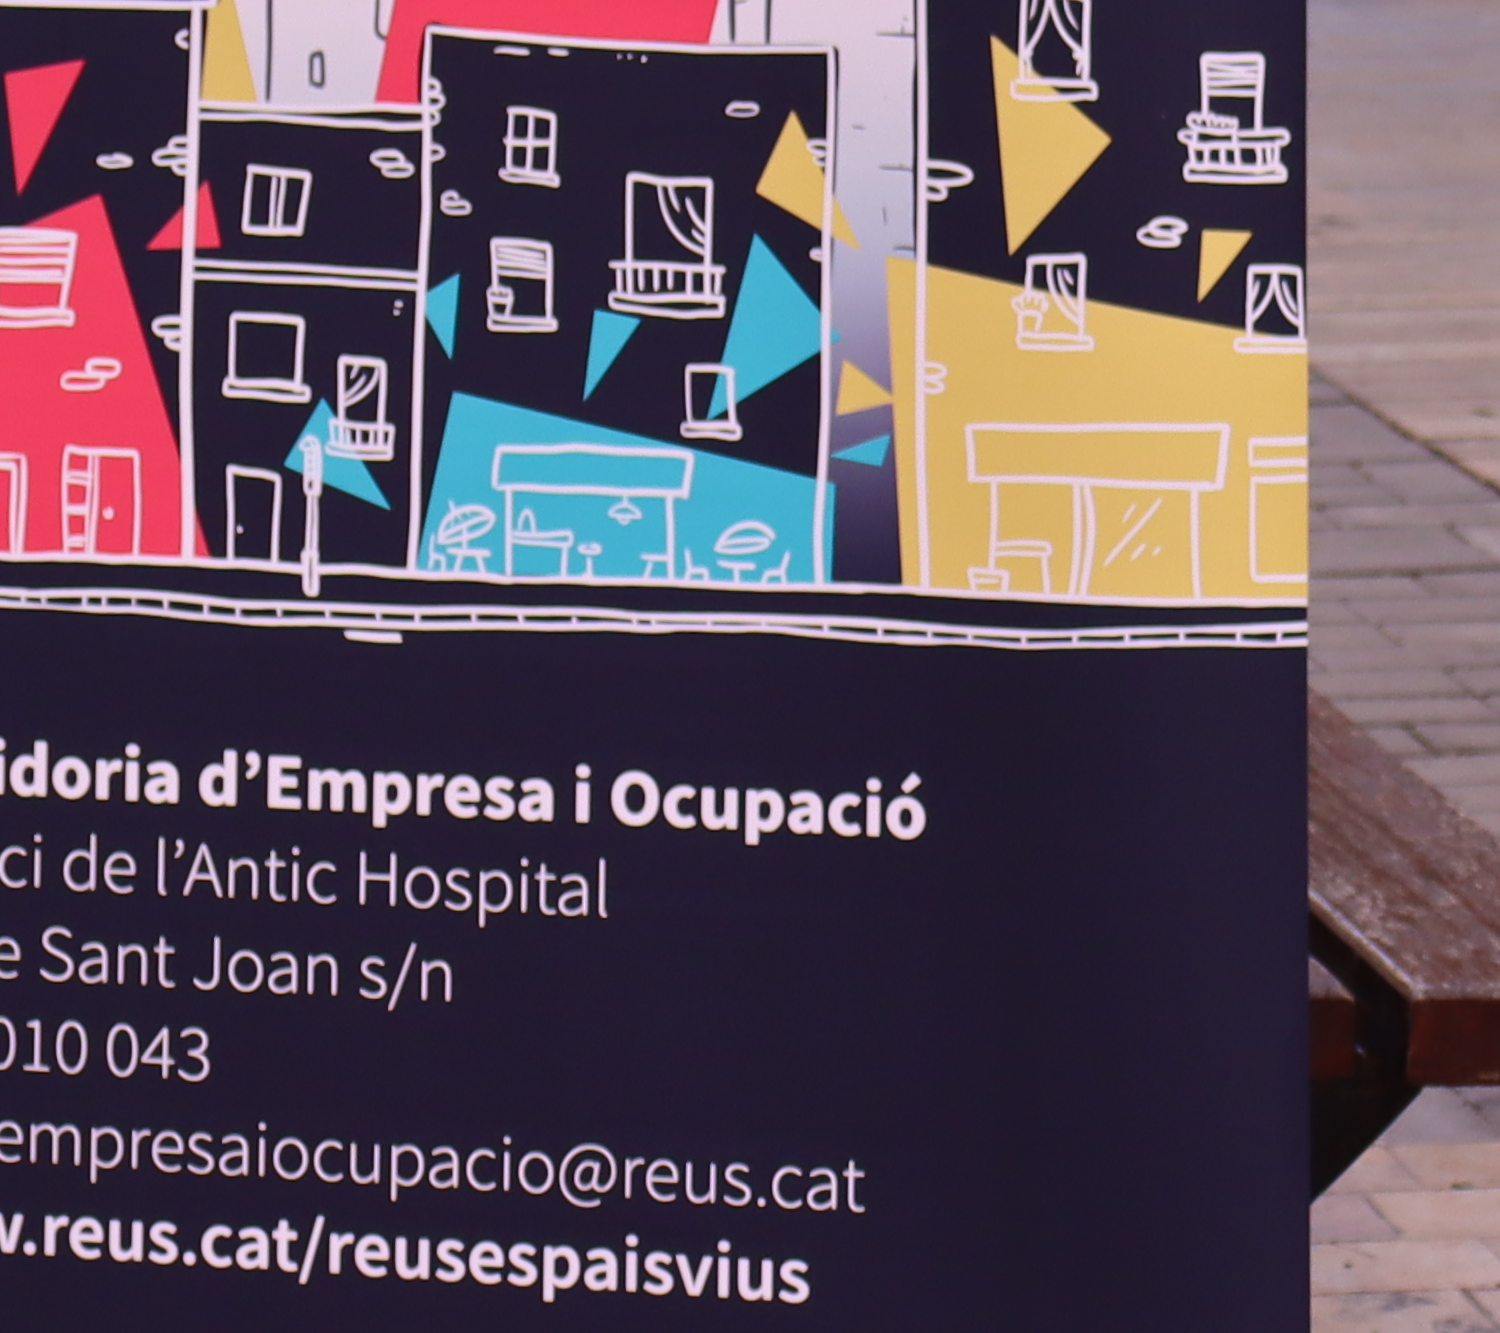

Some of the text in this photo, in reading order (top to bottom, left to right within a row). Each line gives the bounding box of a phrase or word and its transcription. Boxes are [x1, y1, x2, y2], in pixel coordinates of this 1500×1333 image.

[198, 748, 555, 829] d’Empresa
[575, 763, 592, 824] i
[610, 770, 927, 846] Ocupació
[62, 833, 137, 895] de
[157, 836, 338, 906] l’Antic
[358, 850, 608, 928] Hospital
[39, 926, 176, 989] Sant
[192, 935, 339, 996] Joan
[359, 942, 453, 1011] s/n
[106, 1023, 211, 1083] 043
